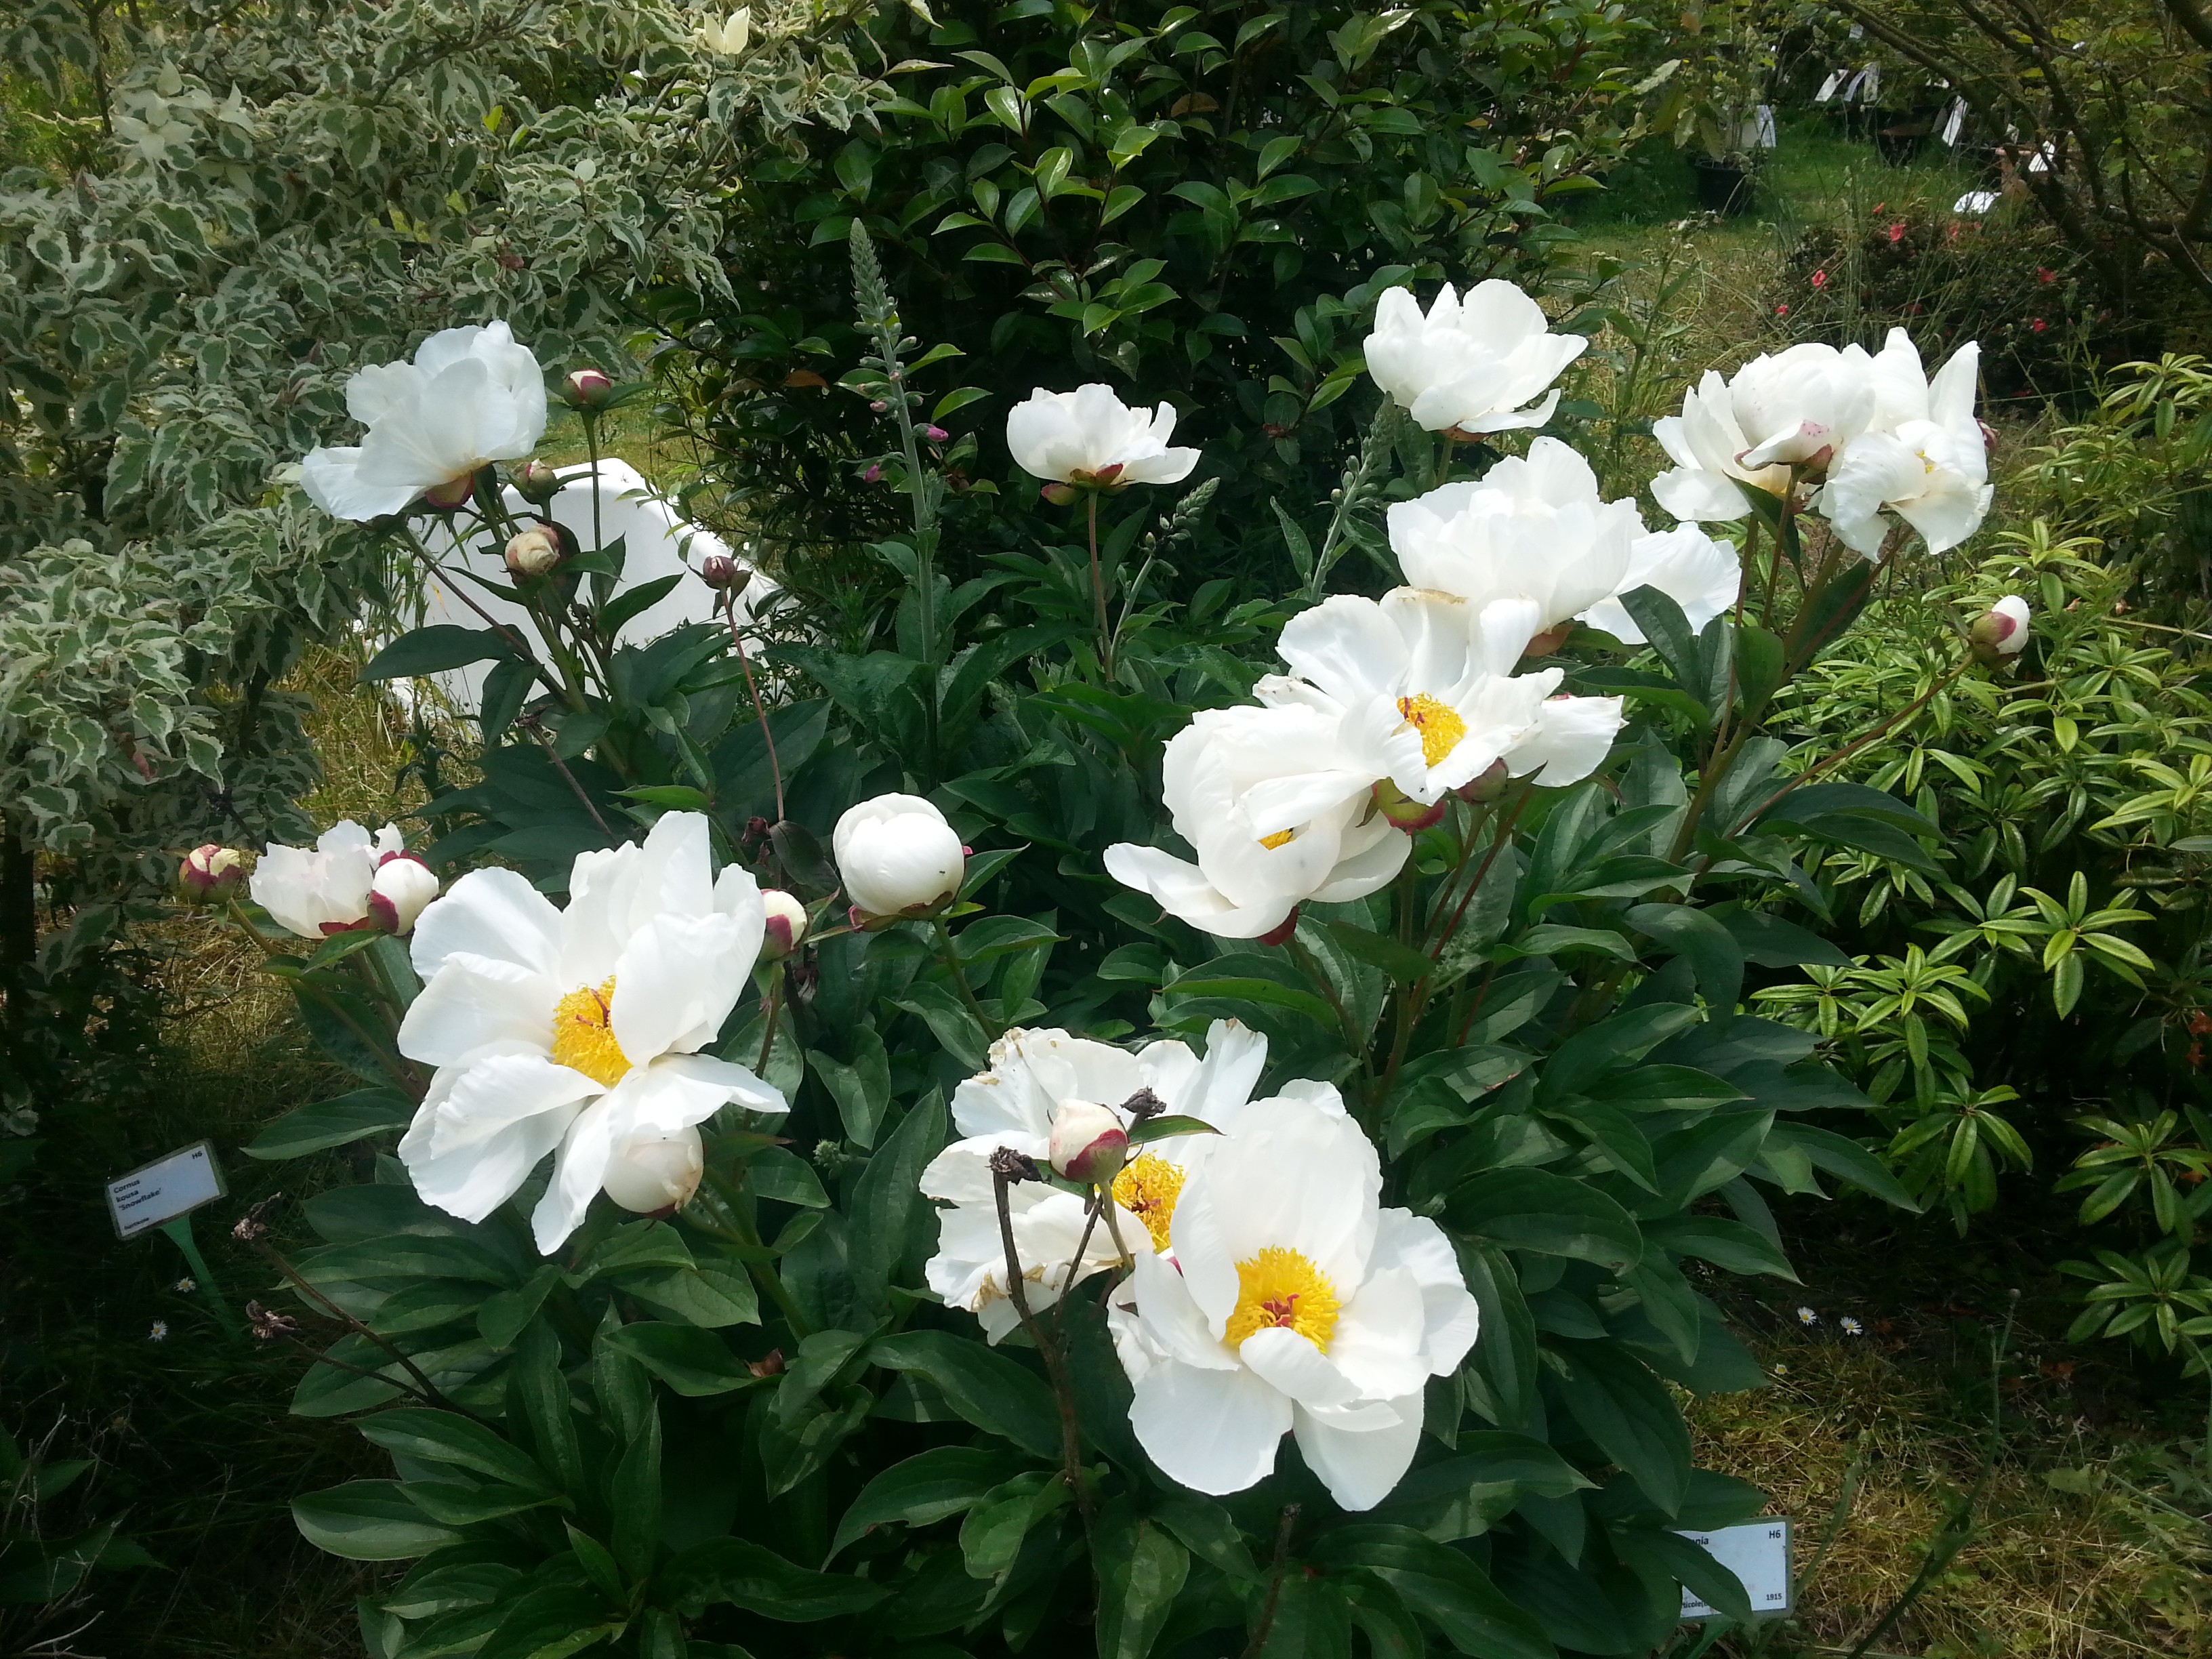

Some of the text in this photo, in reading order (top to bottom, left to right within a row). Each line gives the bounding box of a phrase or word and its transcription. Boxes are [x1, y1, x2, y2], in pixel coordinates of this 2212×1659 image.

[114, 1179, 140, 1193] Cornus
[116, 1189, 139, 1202] kousa
[1769, 1530, 1781, 1539] H6
